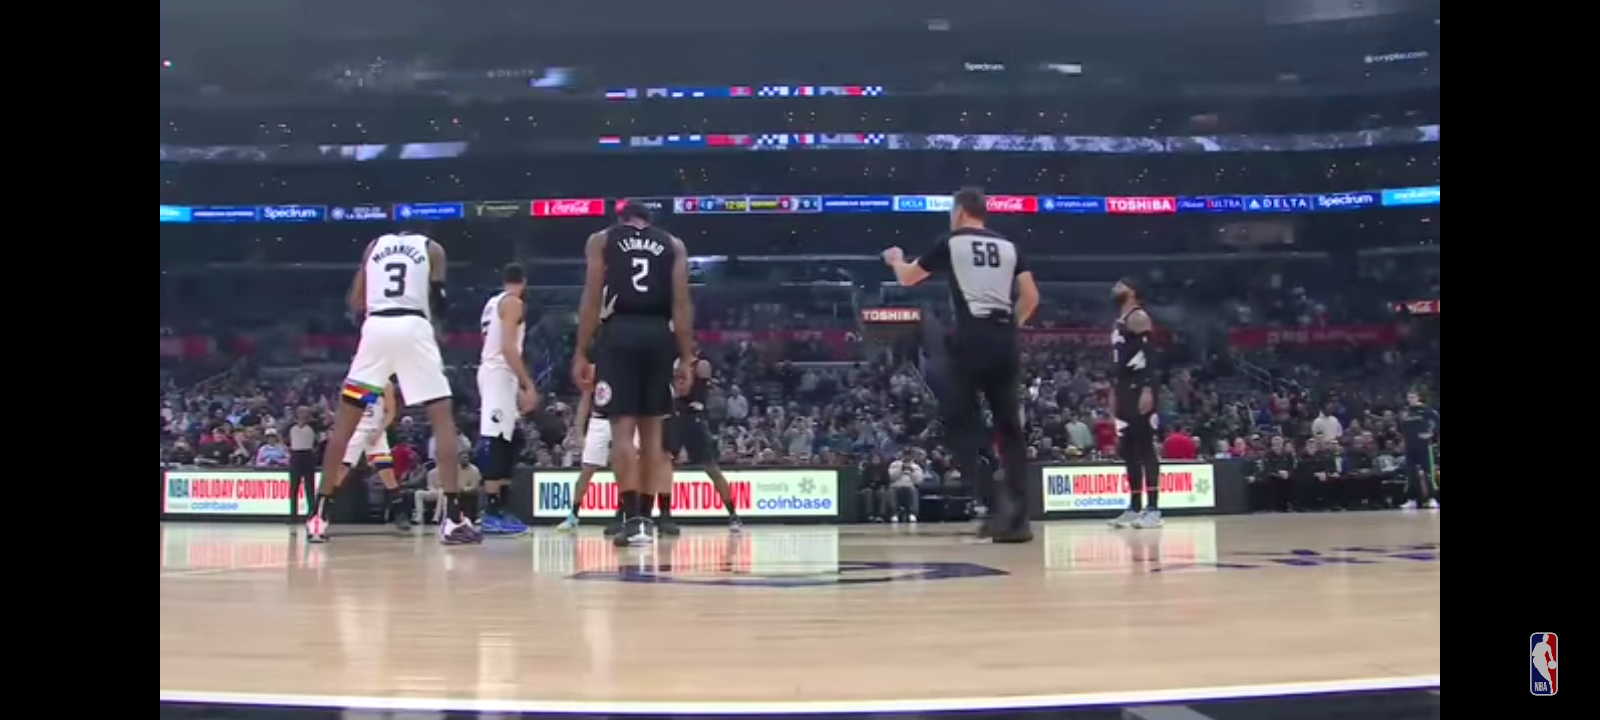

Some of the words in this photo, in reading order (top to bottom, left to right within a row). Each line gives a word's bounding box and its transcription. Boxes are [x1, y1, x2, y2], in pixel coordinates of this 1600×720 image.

[900, 200, 924, 208] UCLA
[1107, 199, 1173, 211] TOSHIBA
[1262, 198, 1307, 208] DELTA
[1318, 193, 1373, 208] Spectrum
[263, 206, 318, 220] Spectrum
[617, 237, 665, 256] LEONARD
[971, 241, 1001, 268] 58
[384, 262, 407, 298] 3
[631, 257, 649, 292] 2
[862, 310, 921, 321] TOSHIBA
[168, 478, 189, 498] NBA
[191, 479, 235, 499] HOLIDAY
[236, 479, 291, 499] COUNTDO
[1047, 474, 1071, 495] NBA
[1072, 474, 1120, 493] HOLIDAY
[538, 482, 571, 510] NBA
[756, 495, 833, 510] coinbase
[1074, 497, 1127, 508] coinbase
[190, 500, 239, 511] coinbase
